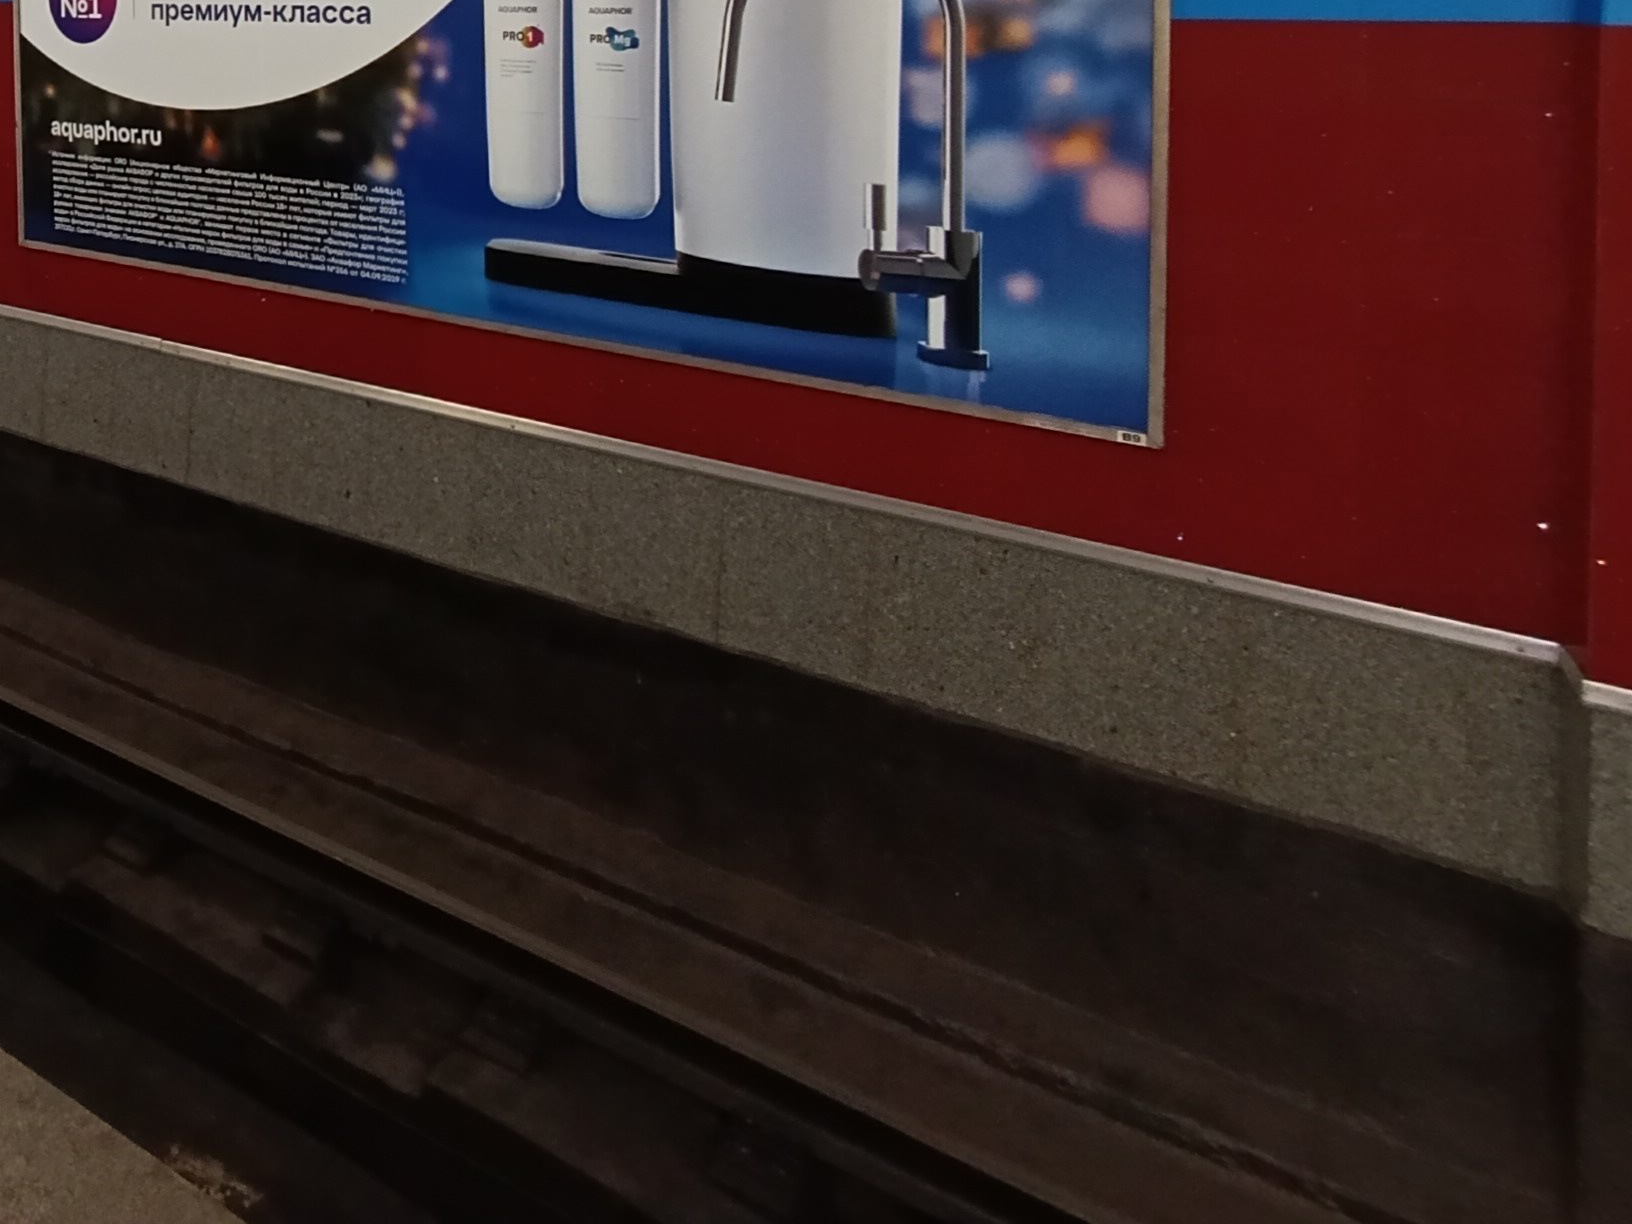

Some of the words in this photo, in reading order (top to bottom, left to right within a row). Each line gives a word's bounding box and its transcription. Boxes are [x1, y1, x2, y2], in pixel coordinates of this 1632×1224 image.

[150, 2, 372, 28] премиум-класса
[498, 6, 538, 14] AQUAPHOR
[588, 7, 633, 15] AQUAPHOR
[51, 120, 162, 146] aquaphor.ru
